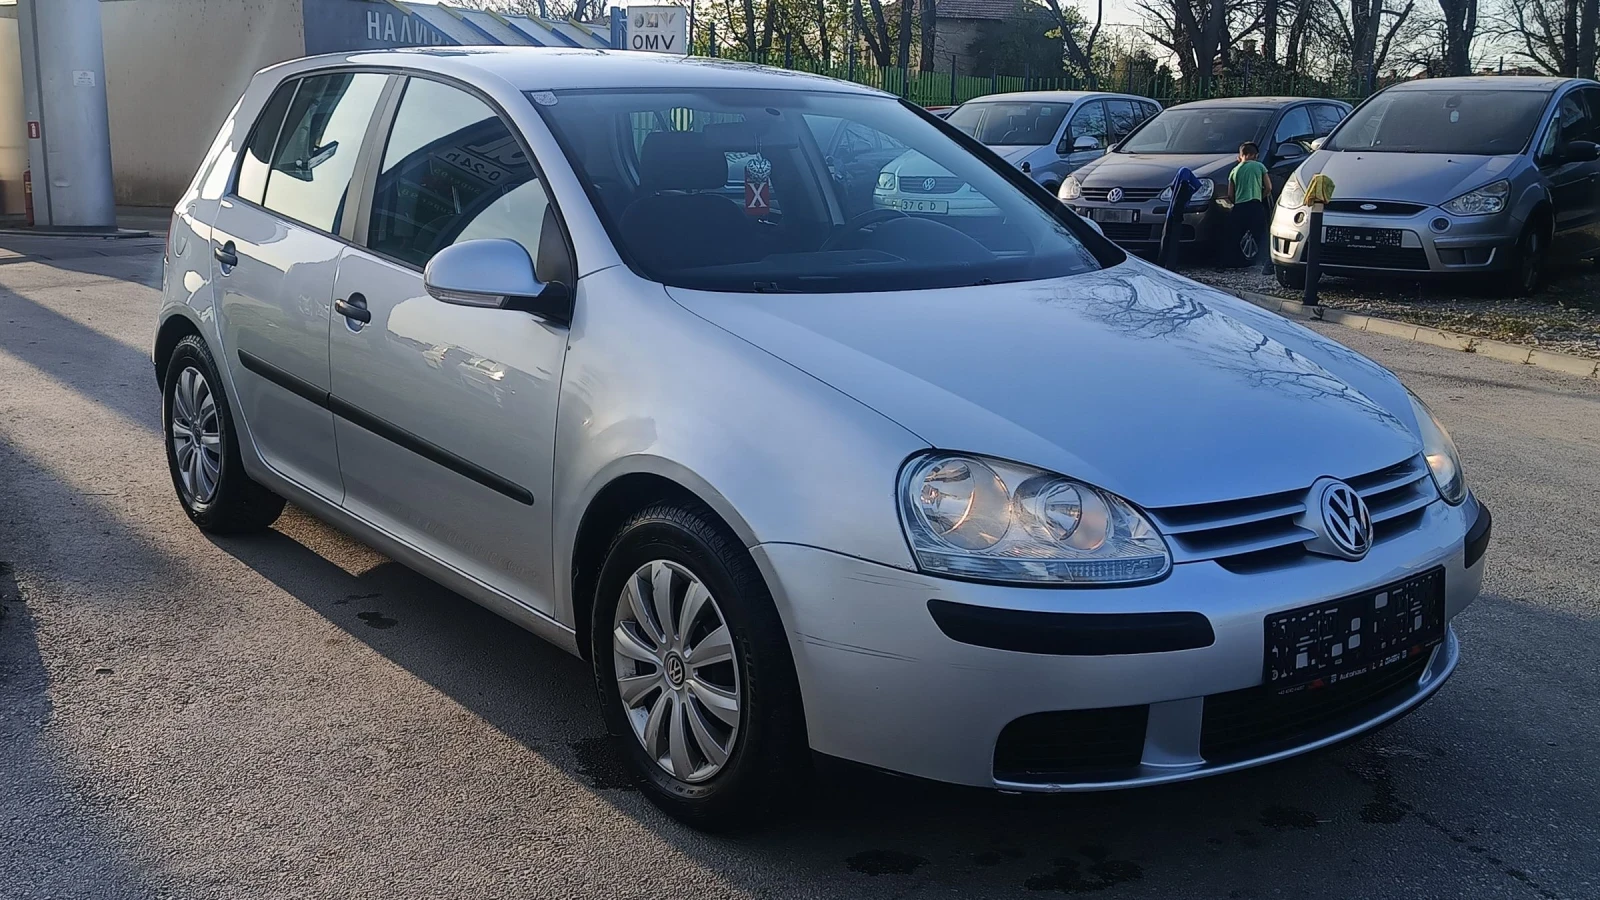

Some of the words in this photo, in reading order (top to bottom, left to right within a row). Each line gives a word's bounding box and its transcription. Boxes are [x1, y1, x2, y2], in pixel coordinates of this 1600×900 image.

[367, 11, 450, 45] НАЛИ
[633, 34, 675, 50] OMV
[747, 182, 768, 208] X
[1339, 667, 1368, 680] Autohaus
